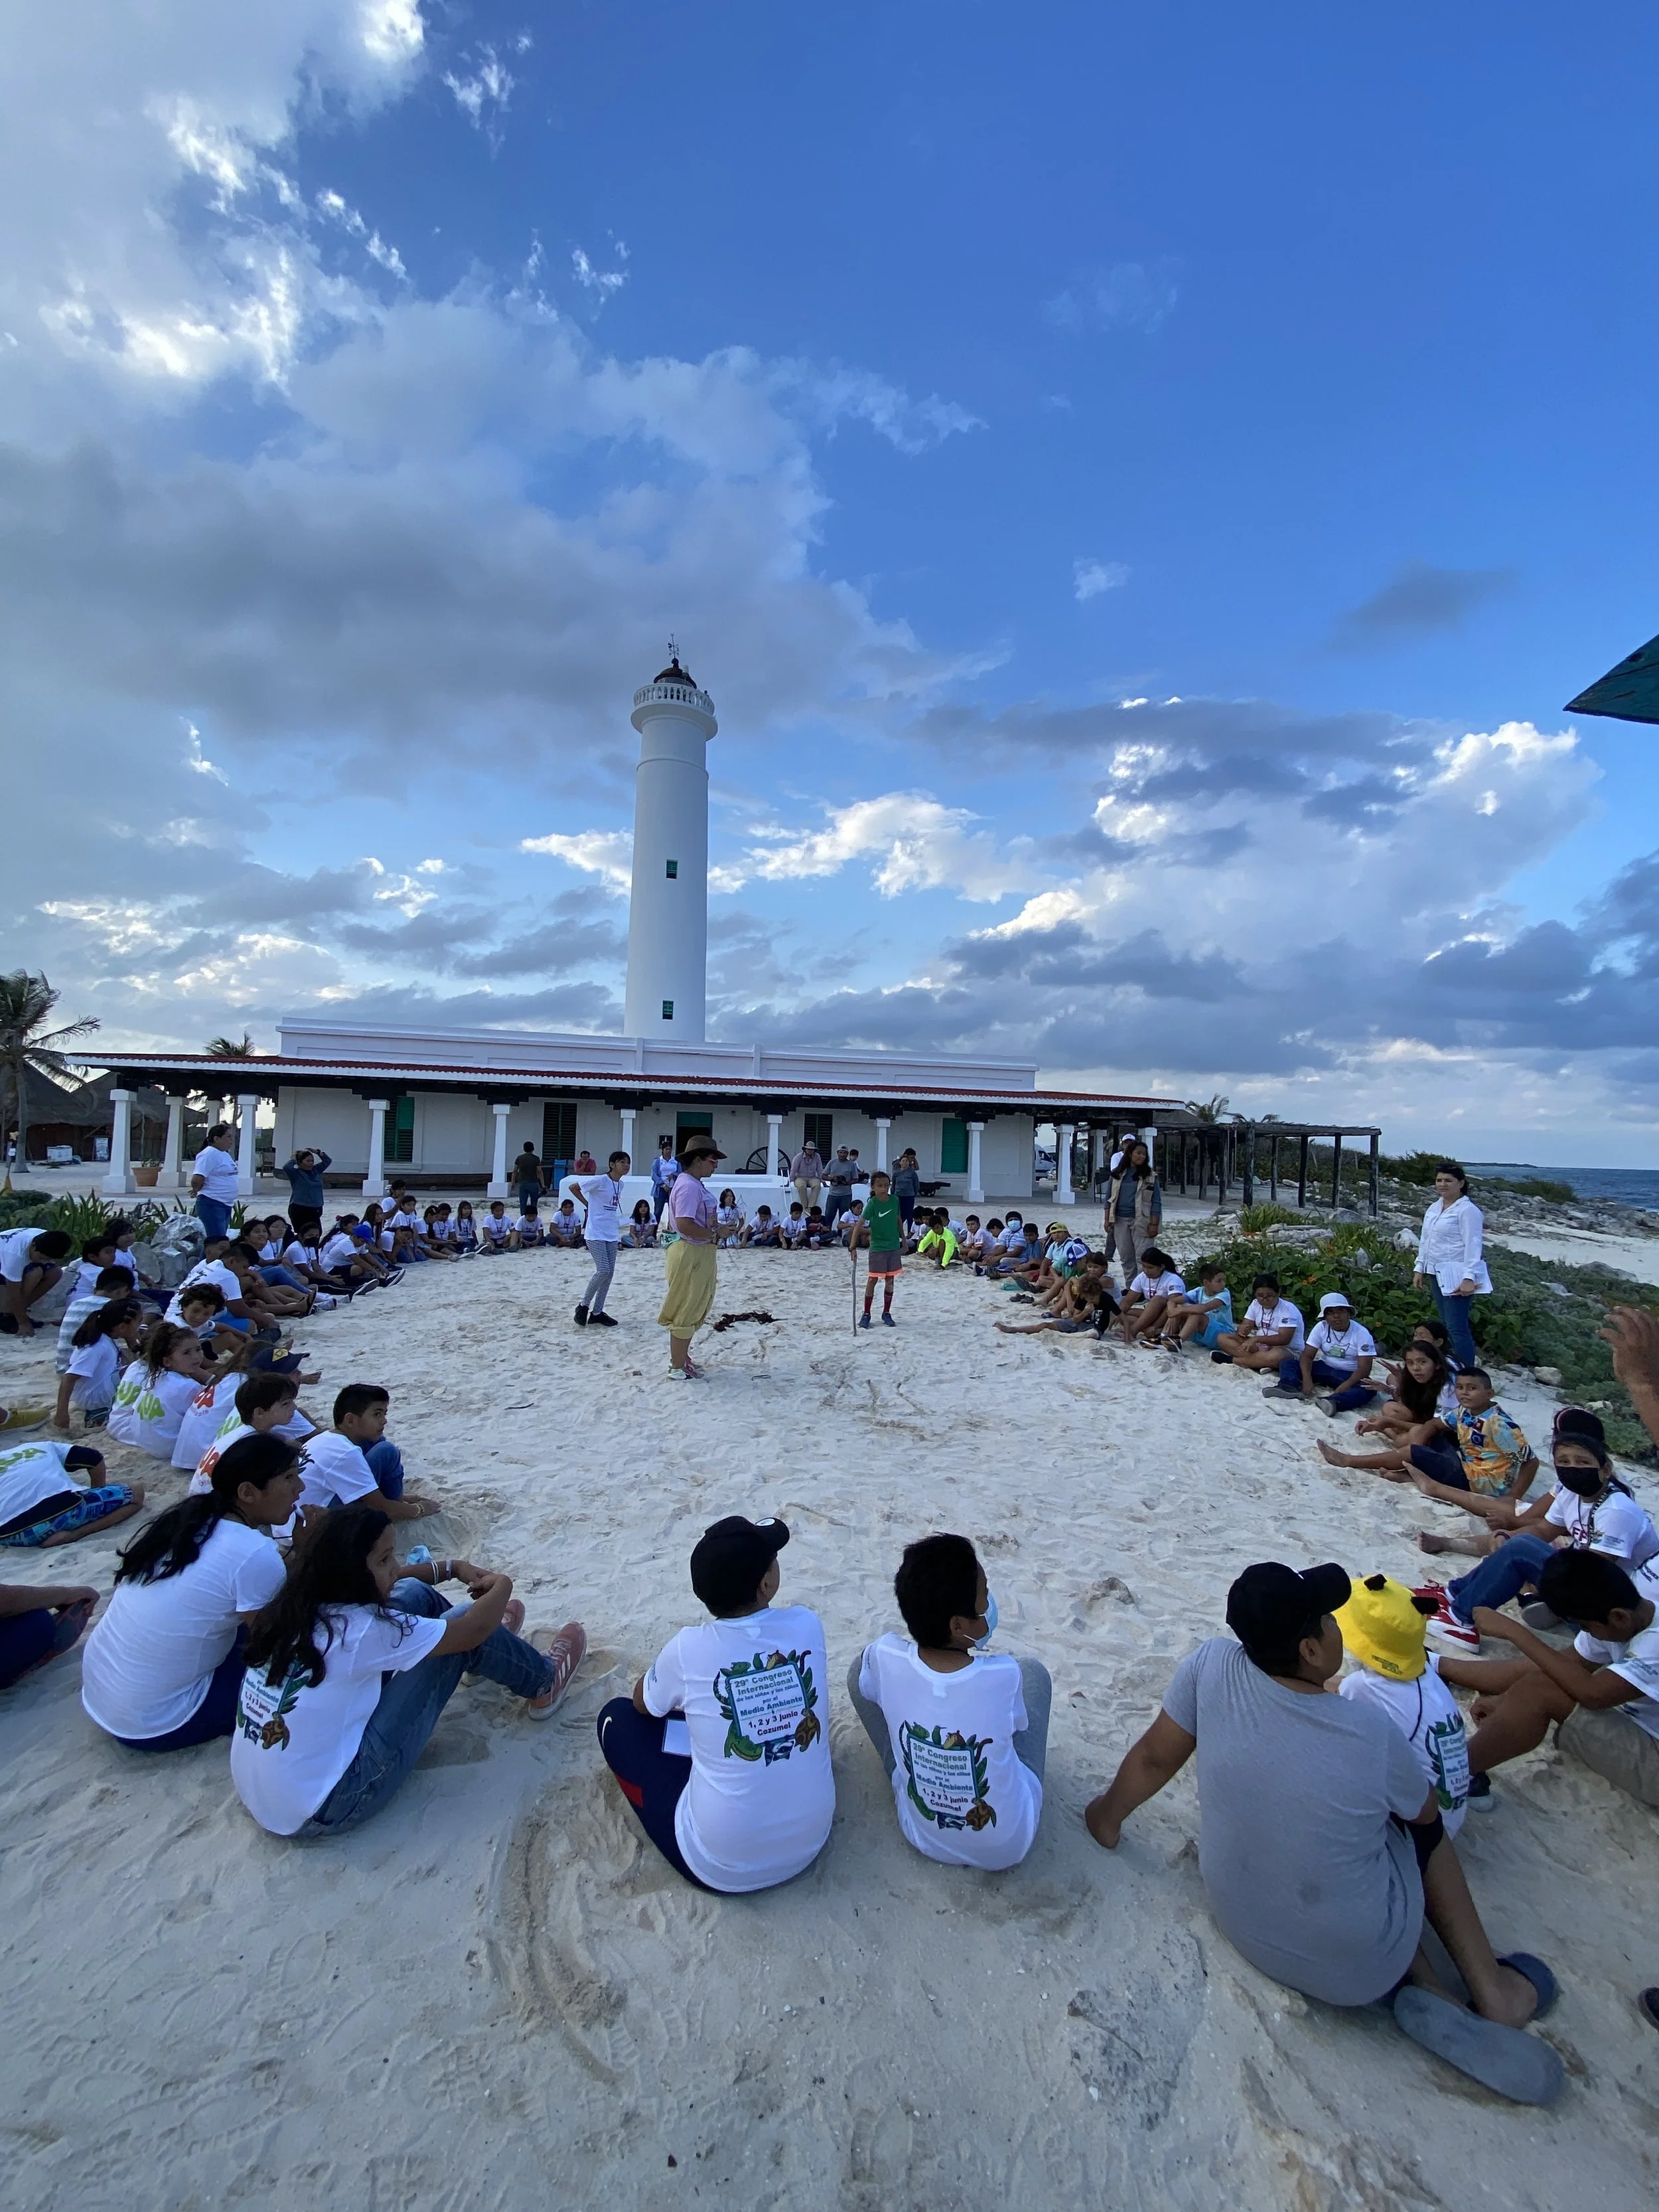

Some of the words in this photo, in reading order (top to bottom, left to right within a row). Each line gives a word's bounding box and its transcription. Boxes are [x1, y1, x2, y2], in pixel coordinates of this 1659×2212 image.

[752, 1669, 792, 1684] Congreso
[738, 1676, 793, 1696] Internacional
[740, 1706, 764, 1717] Medio
[767, 1696, 803, 1710] Ambiente
[779, 1710, 798, 1722] junio
[757, 1722, 791, 1736] Cozumel
[915, 1753, 967, 1770] Internacional
[928, 1749, 968, 1763] Congreso
[916, 1773, 936, 1785] Medio
[939, 1782, 973, 1791] Ambiente
[930, 1799, 962, 1812] Cozumel
